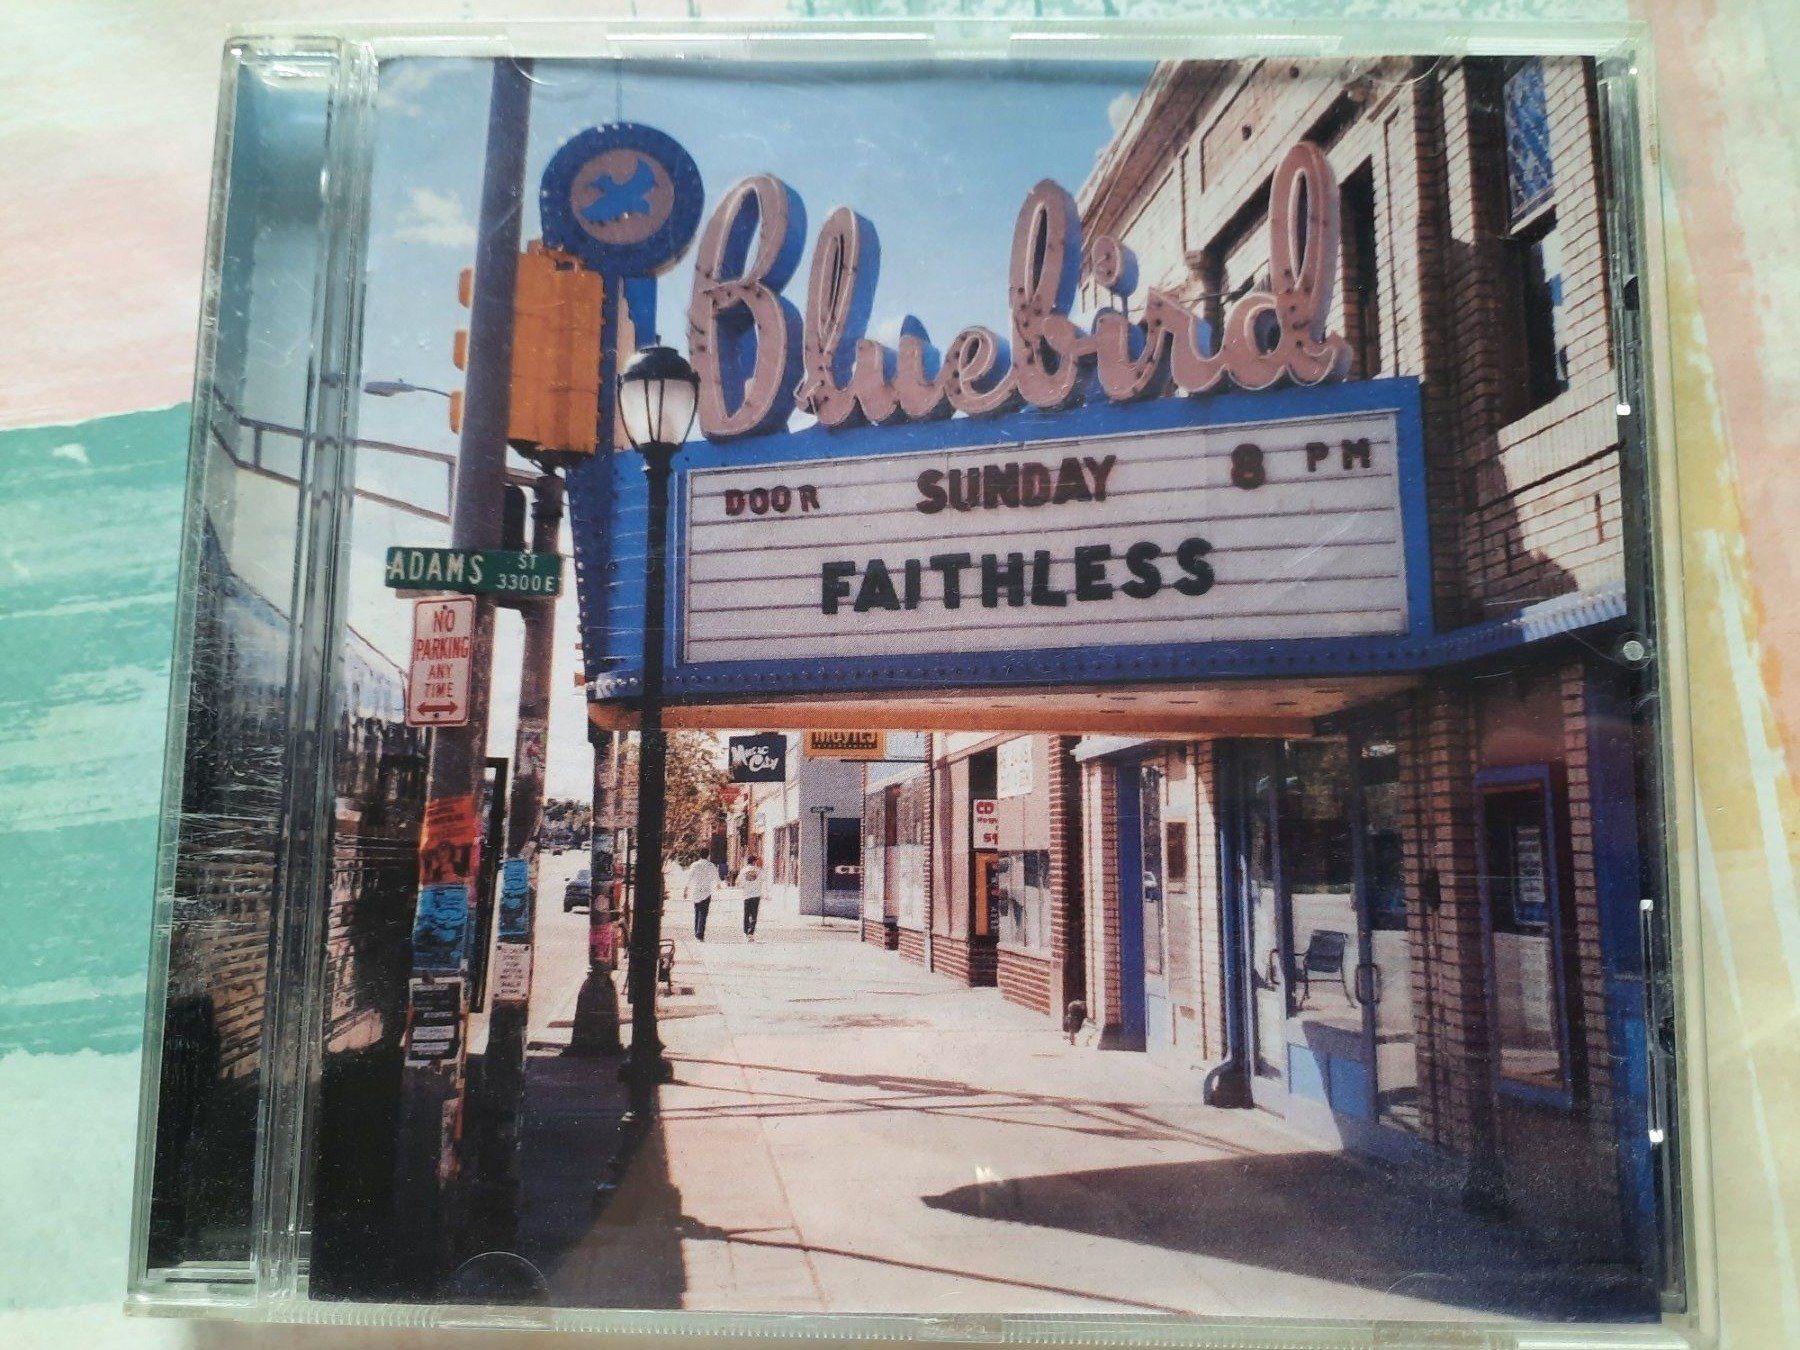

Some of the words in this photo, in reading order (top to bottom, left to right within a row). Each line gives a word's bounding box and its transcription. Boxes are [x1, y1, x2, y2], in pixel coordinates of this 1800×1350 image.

[689, 141, 1354, 439] Bluebird
[723, 484, 821, 517] DOOR
[916, 454, 1118, 515] SUNDAY
[1231, 442, 1267, 490] 8
[1305, 437, 1373, 473] PM
[388, 550, 485, 585] ADAMS
[517, 553, 539, 570] ST
[820, 538, 1217, 616] FAITHLESS
[432, 608, 457, 633] NO
[414, 636, 471, 662] PARKING
[427, 663, 455, 681] ANY
[424, 682, 454, 699] TIME
